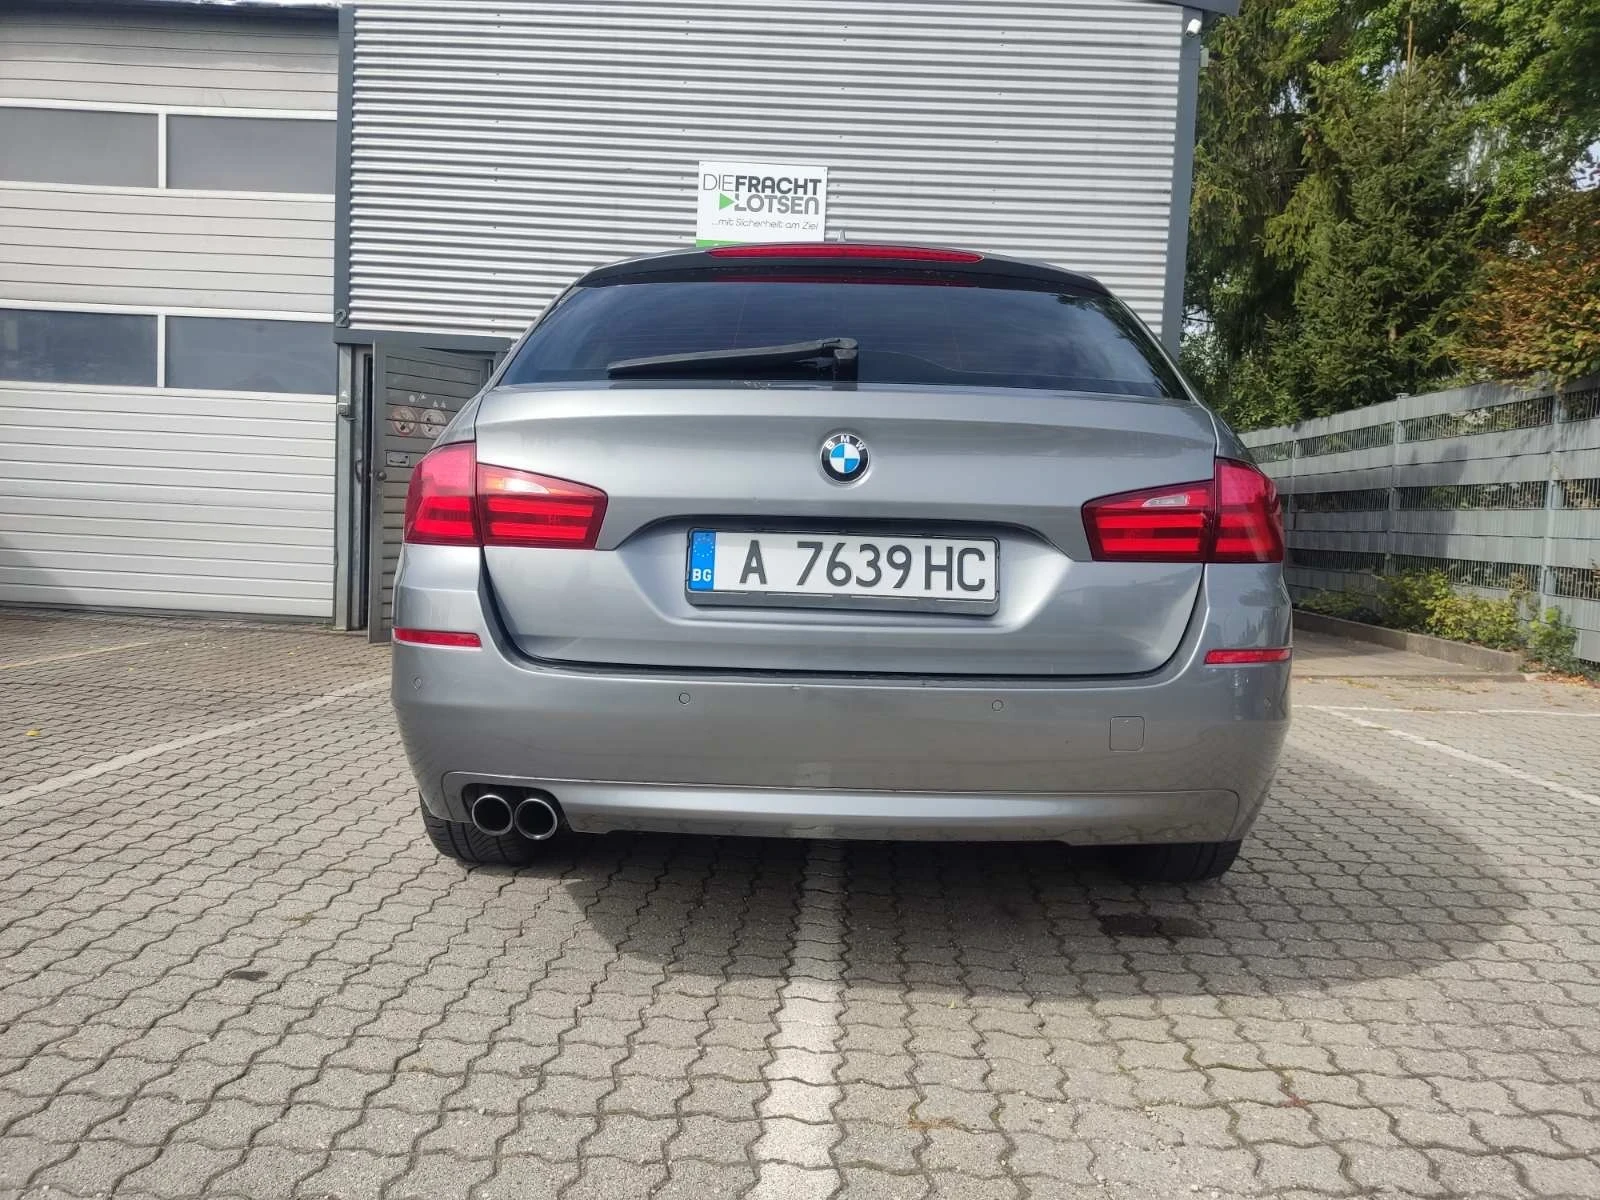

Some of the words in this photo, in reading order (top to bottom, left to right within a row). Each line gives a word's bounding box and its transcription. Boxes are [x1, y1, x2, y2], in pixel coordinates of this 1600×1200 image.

[734, 193, 819, 215] LOTSEN
[736, 218, 783, 229] Sicherheit
[785, 221, 800, 230] am
[802, 221, 819, 231] Ziel
[335, 308, 347, 327] 2
[824, 434, 866, 451] BMW
[739, 539, 768, 585] A
[692, 568, 712, 582] BG
